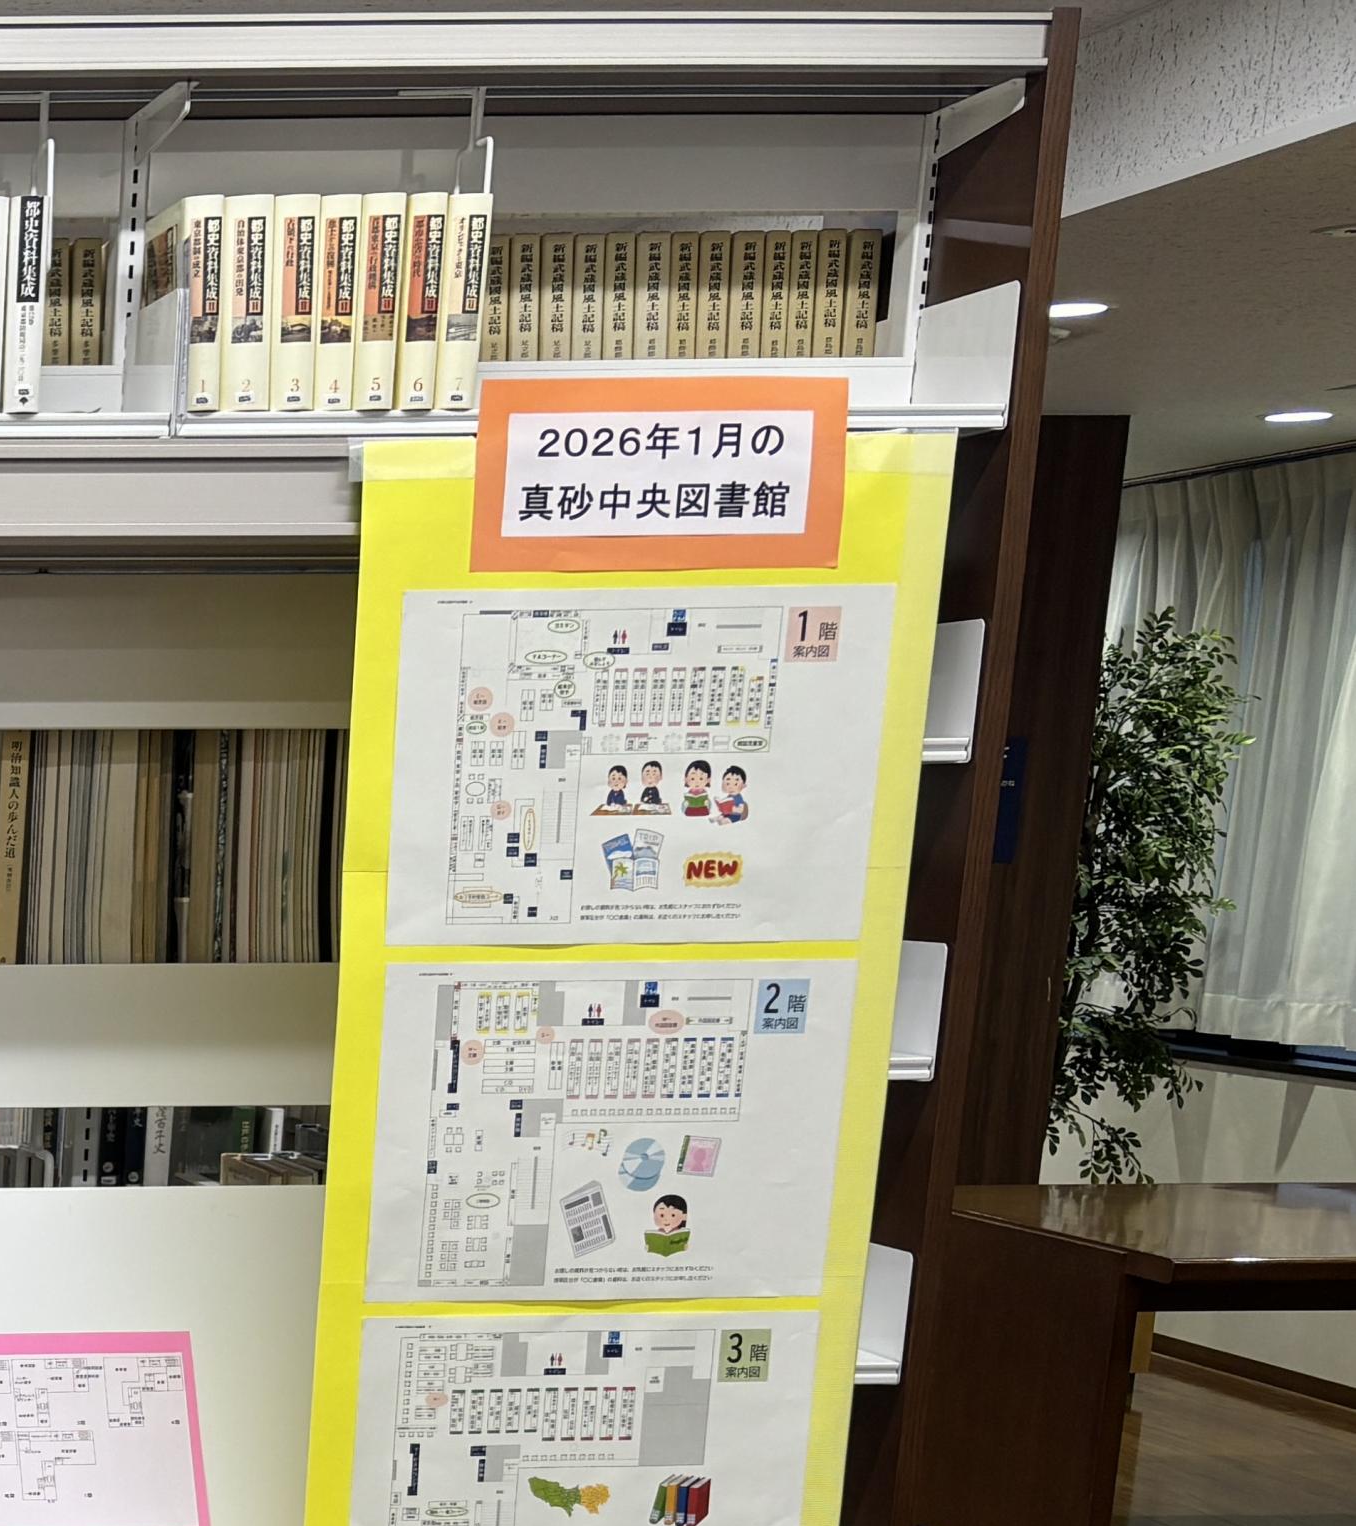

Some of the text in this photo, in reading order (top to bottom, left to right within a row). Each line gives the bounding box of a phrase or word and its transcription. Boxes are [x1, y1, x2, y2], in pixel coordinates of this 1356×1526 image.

[199, 380, 206, 392] 1
[241, 380, 251, 392] 2
[291, 379, 300, 391] 3
[329, 379, 339, 392] 4
[371, 378, 380, 391] 5
[413, 378, 423, 391] 6
[537, 422, 786, 461] 2026年1月の
[517, 481, 791, 522] 真砂中央図書館
[792, 645, 830, 659] 案内図
[2, 740, 25, 860] 明治知識人の歩んだ道
[686, 859, 739, 881] NEW
[761, 1017, 800, 1030] 案内図
[724, 1366, 761, 1379] 案内図
